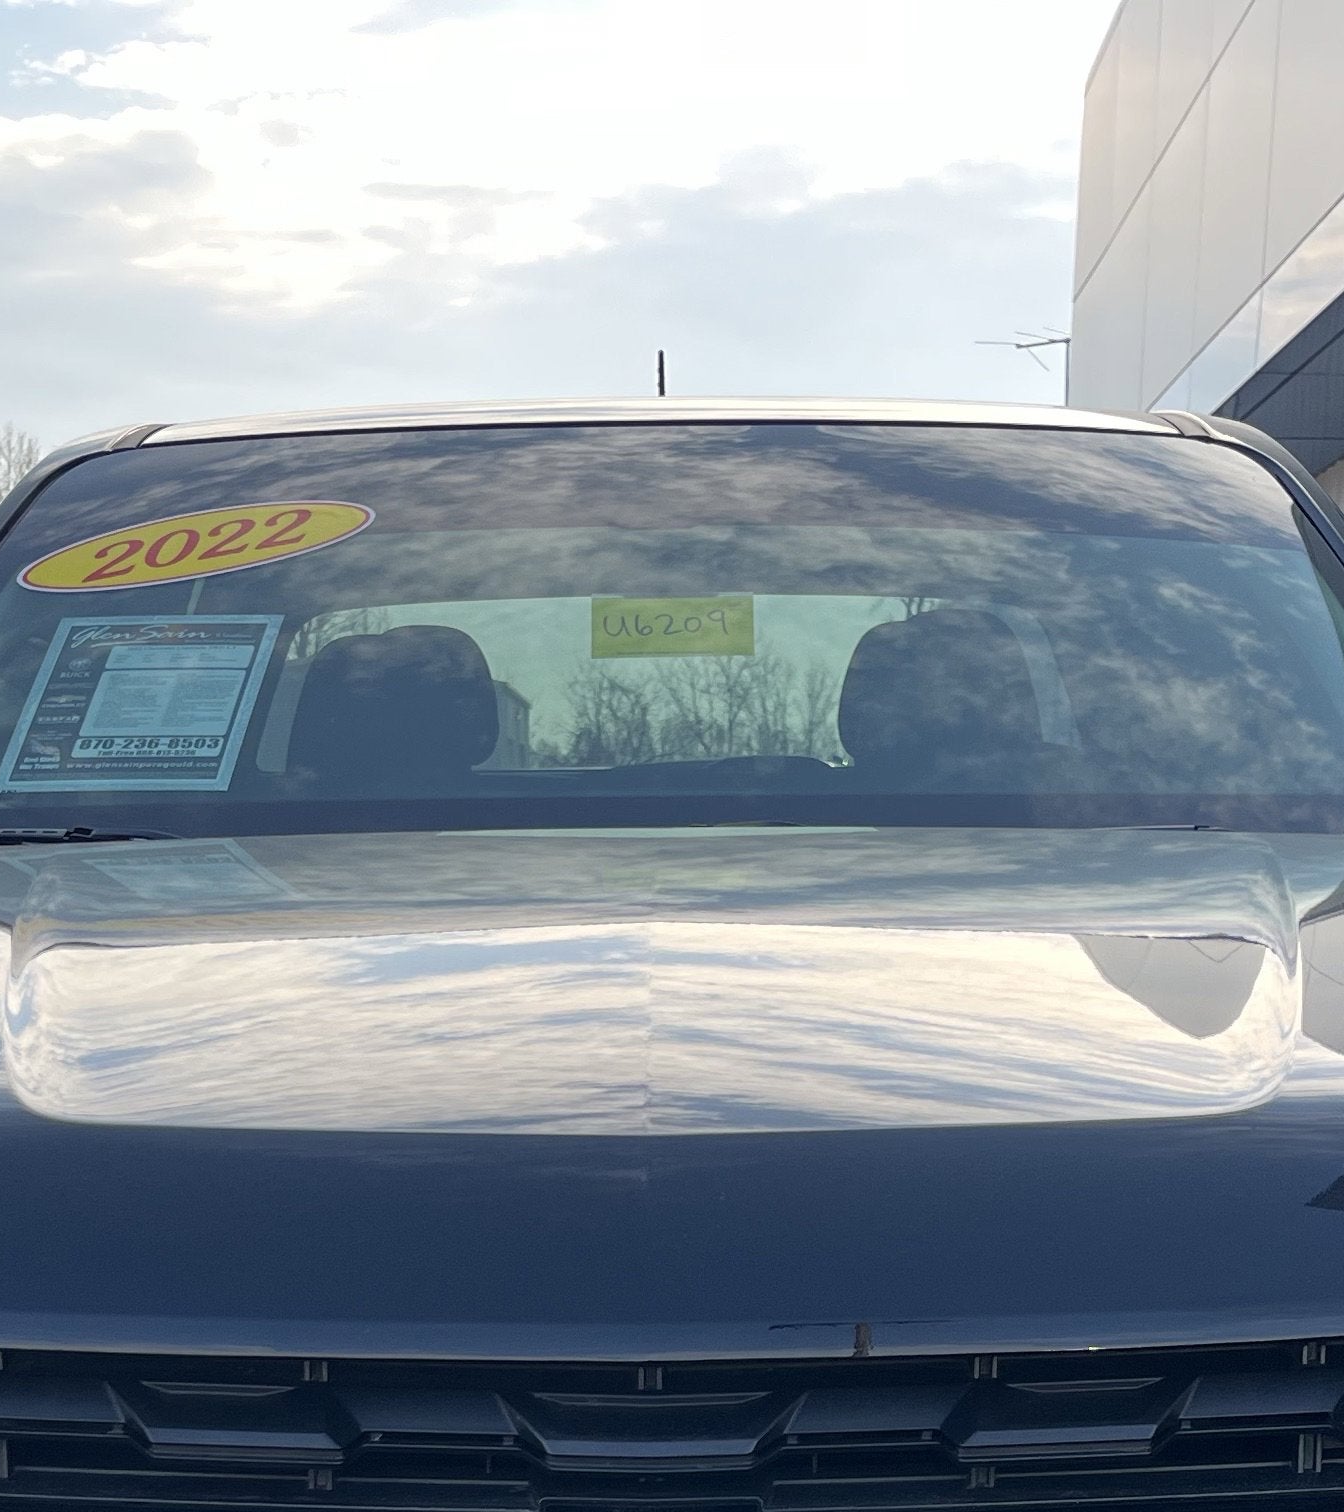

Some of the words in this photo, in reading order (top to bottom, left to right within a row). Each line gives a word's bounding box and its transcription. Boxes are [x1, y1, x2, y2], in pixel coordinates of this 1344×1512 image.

[81, 509, 313, 583] 2022
[71, 625, 137, 649] Glen
[135, 624, 212, 643] Sain
[602, 608, 730, 638] U6209
[78, 738, 221, 750] 870-236-8503
